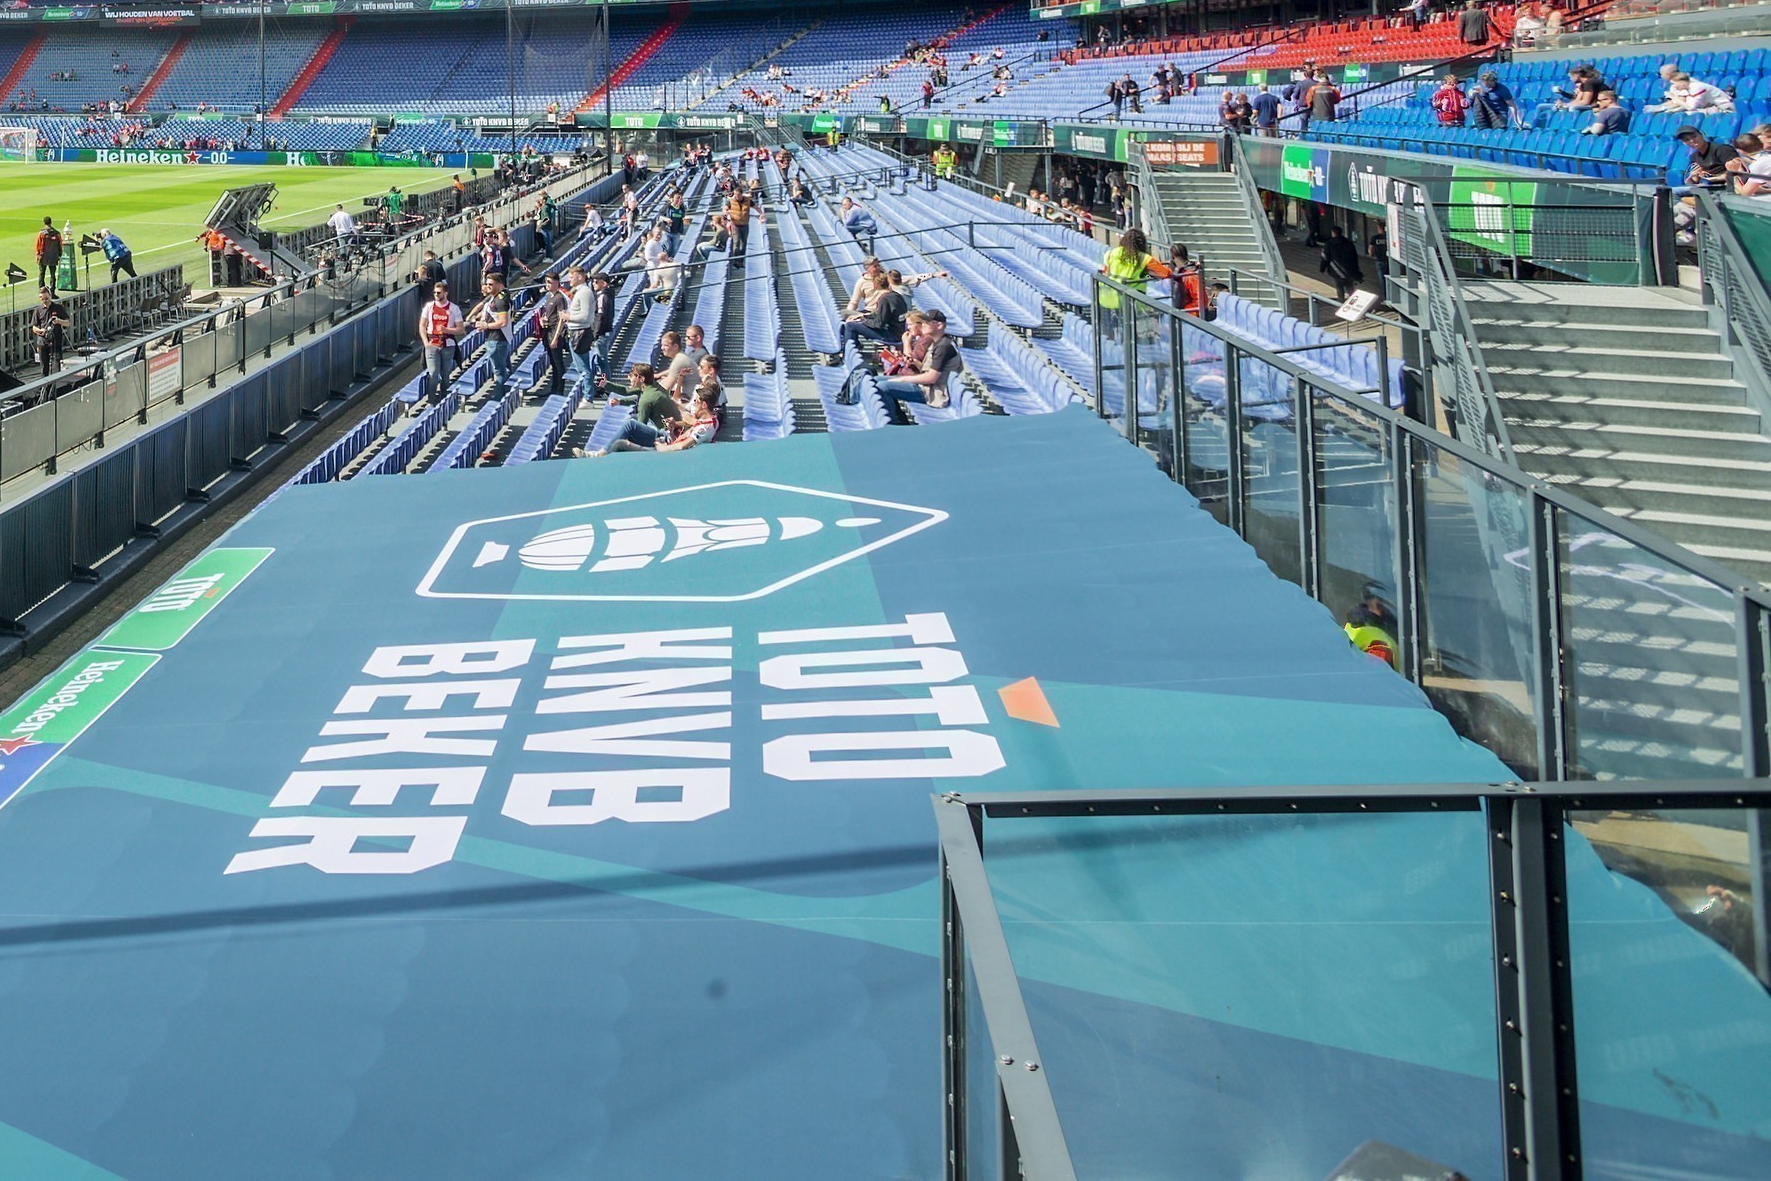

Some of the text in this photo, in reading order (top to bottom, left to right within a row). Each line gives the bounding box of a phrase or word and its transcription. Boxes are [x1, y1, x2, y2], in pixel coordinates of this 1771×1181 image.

[303, 5, 319, 13] TOTO
[625, 117, 643, 127] TOTO
[96, 150, 183, 165] Heineken
[1176, 143, 1191, 151] BIJ
[1193, 143, 1205, 151] DE
[1177, 153, 1205, 161] SEATS
[139, 573, 225, 613] TOTO
[11, 660, 125, 733] Heineken
[758, 612, 1007, 781] TOTO
[501, 626, 732, 825] KNVB
[223, 638, 538, 875] BEKER
